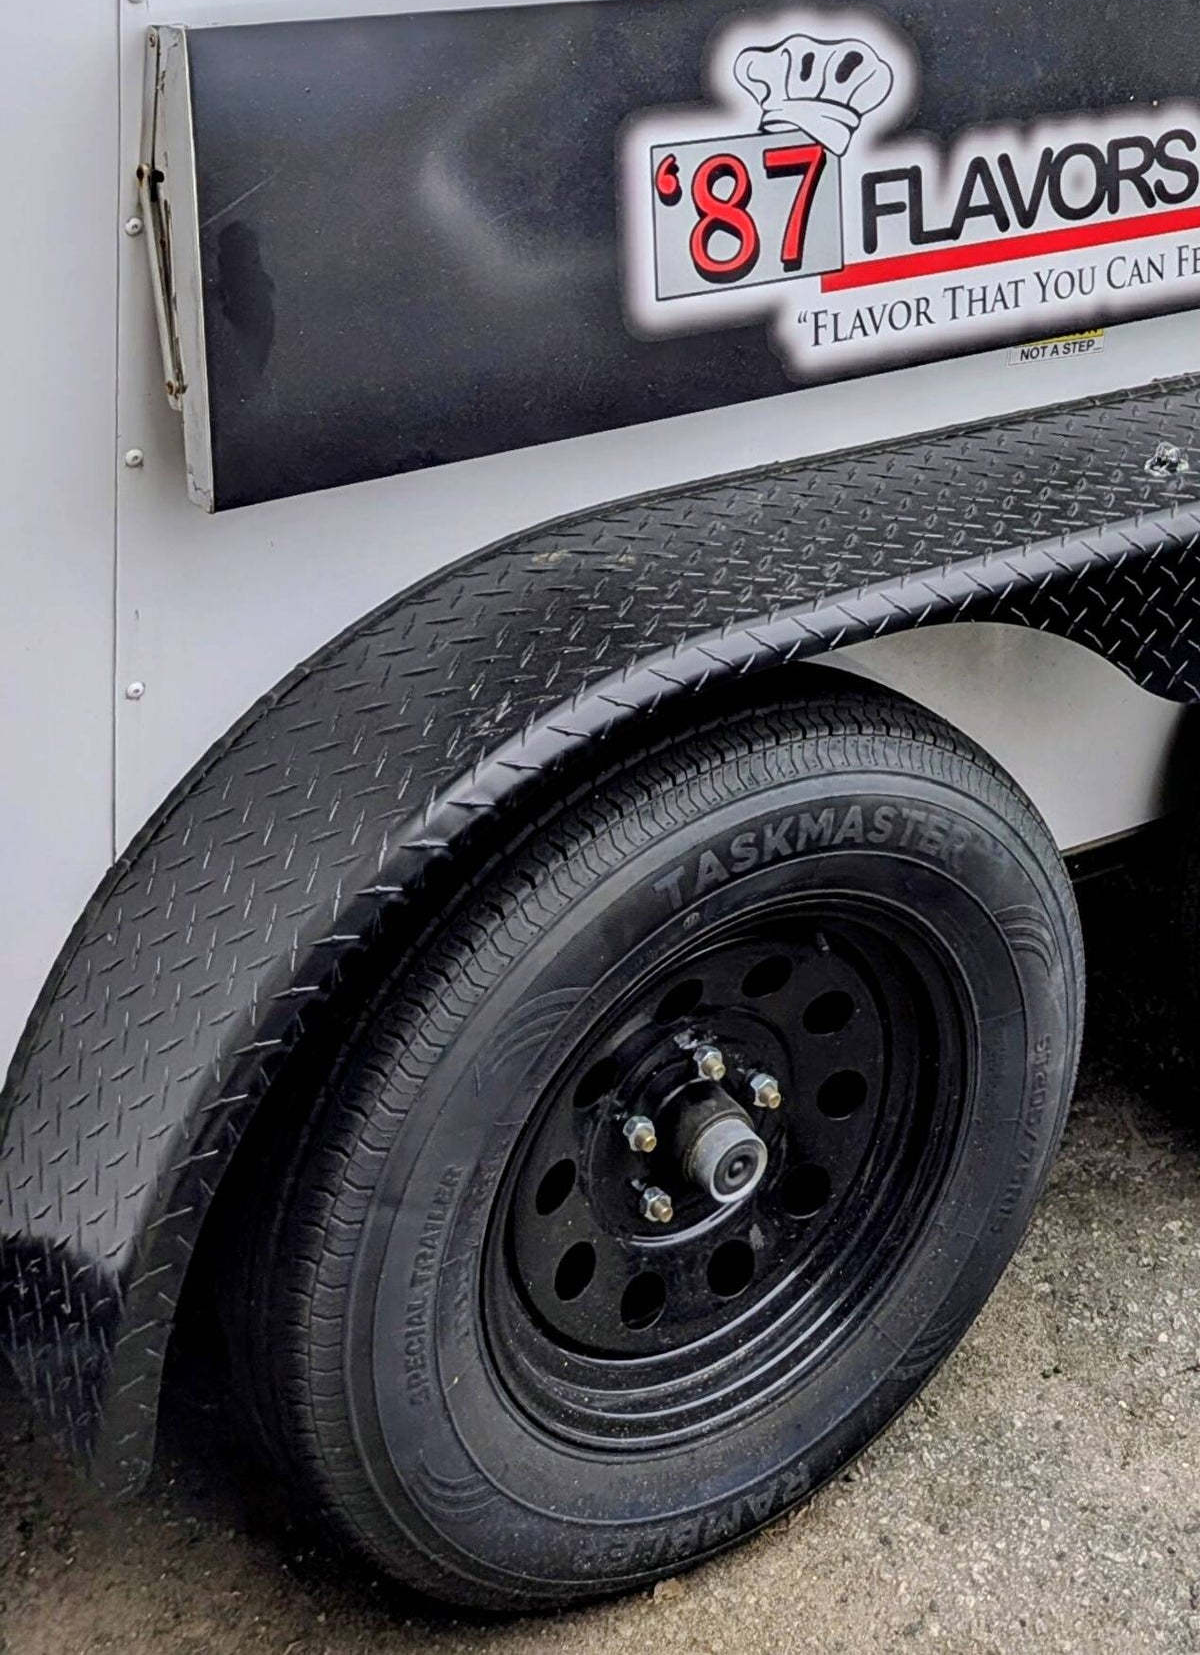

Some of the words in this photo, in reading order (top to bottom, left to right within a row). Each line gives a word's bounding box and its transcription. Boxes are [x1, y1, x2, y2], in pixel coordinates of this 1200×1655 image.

[654, 144, 828, 284] '87
[861, 129, 1200, 255] FLAVORS
[943, 282, 1024, 324] THAT
[1026, 269, 1095, 305] YOU
[1106, 255, 1165, 290] CAN
[1019, 346, 1048, 362] NOT
[1050, 344, 1060, 357] A
[1062, 339, 1095, 355] STEP
[652, 805, 973, 911] TASKMASTER
[410, 1163, 464, 1288] TRAILER
[403, 1293, 430, 1405] SPECIAL
